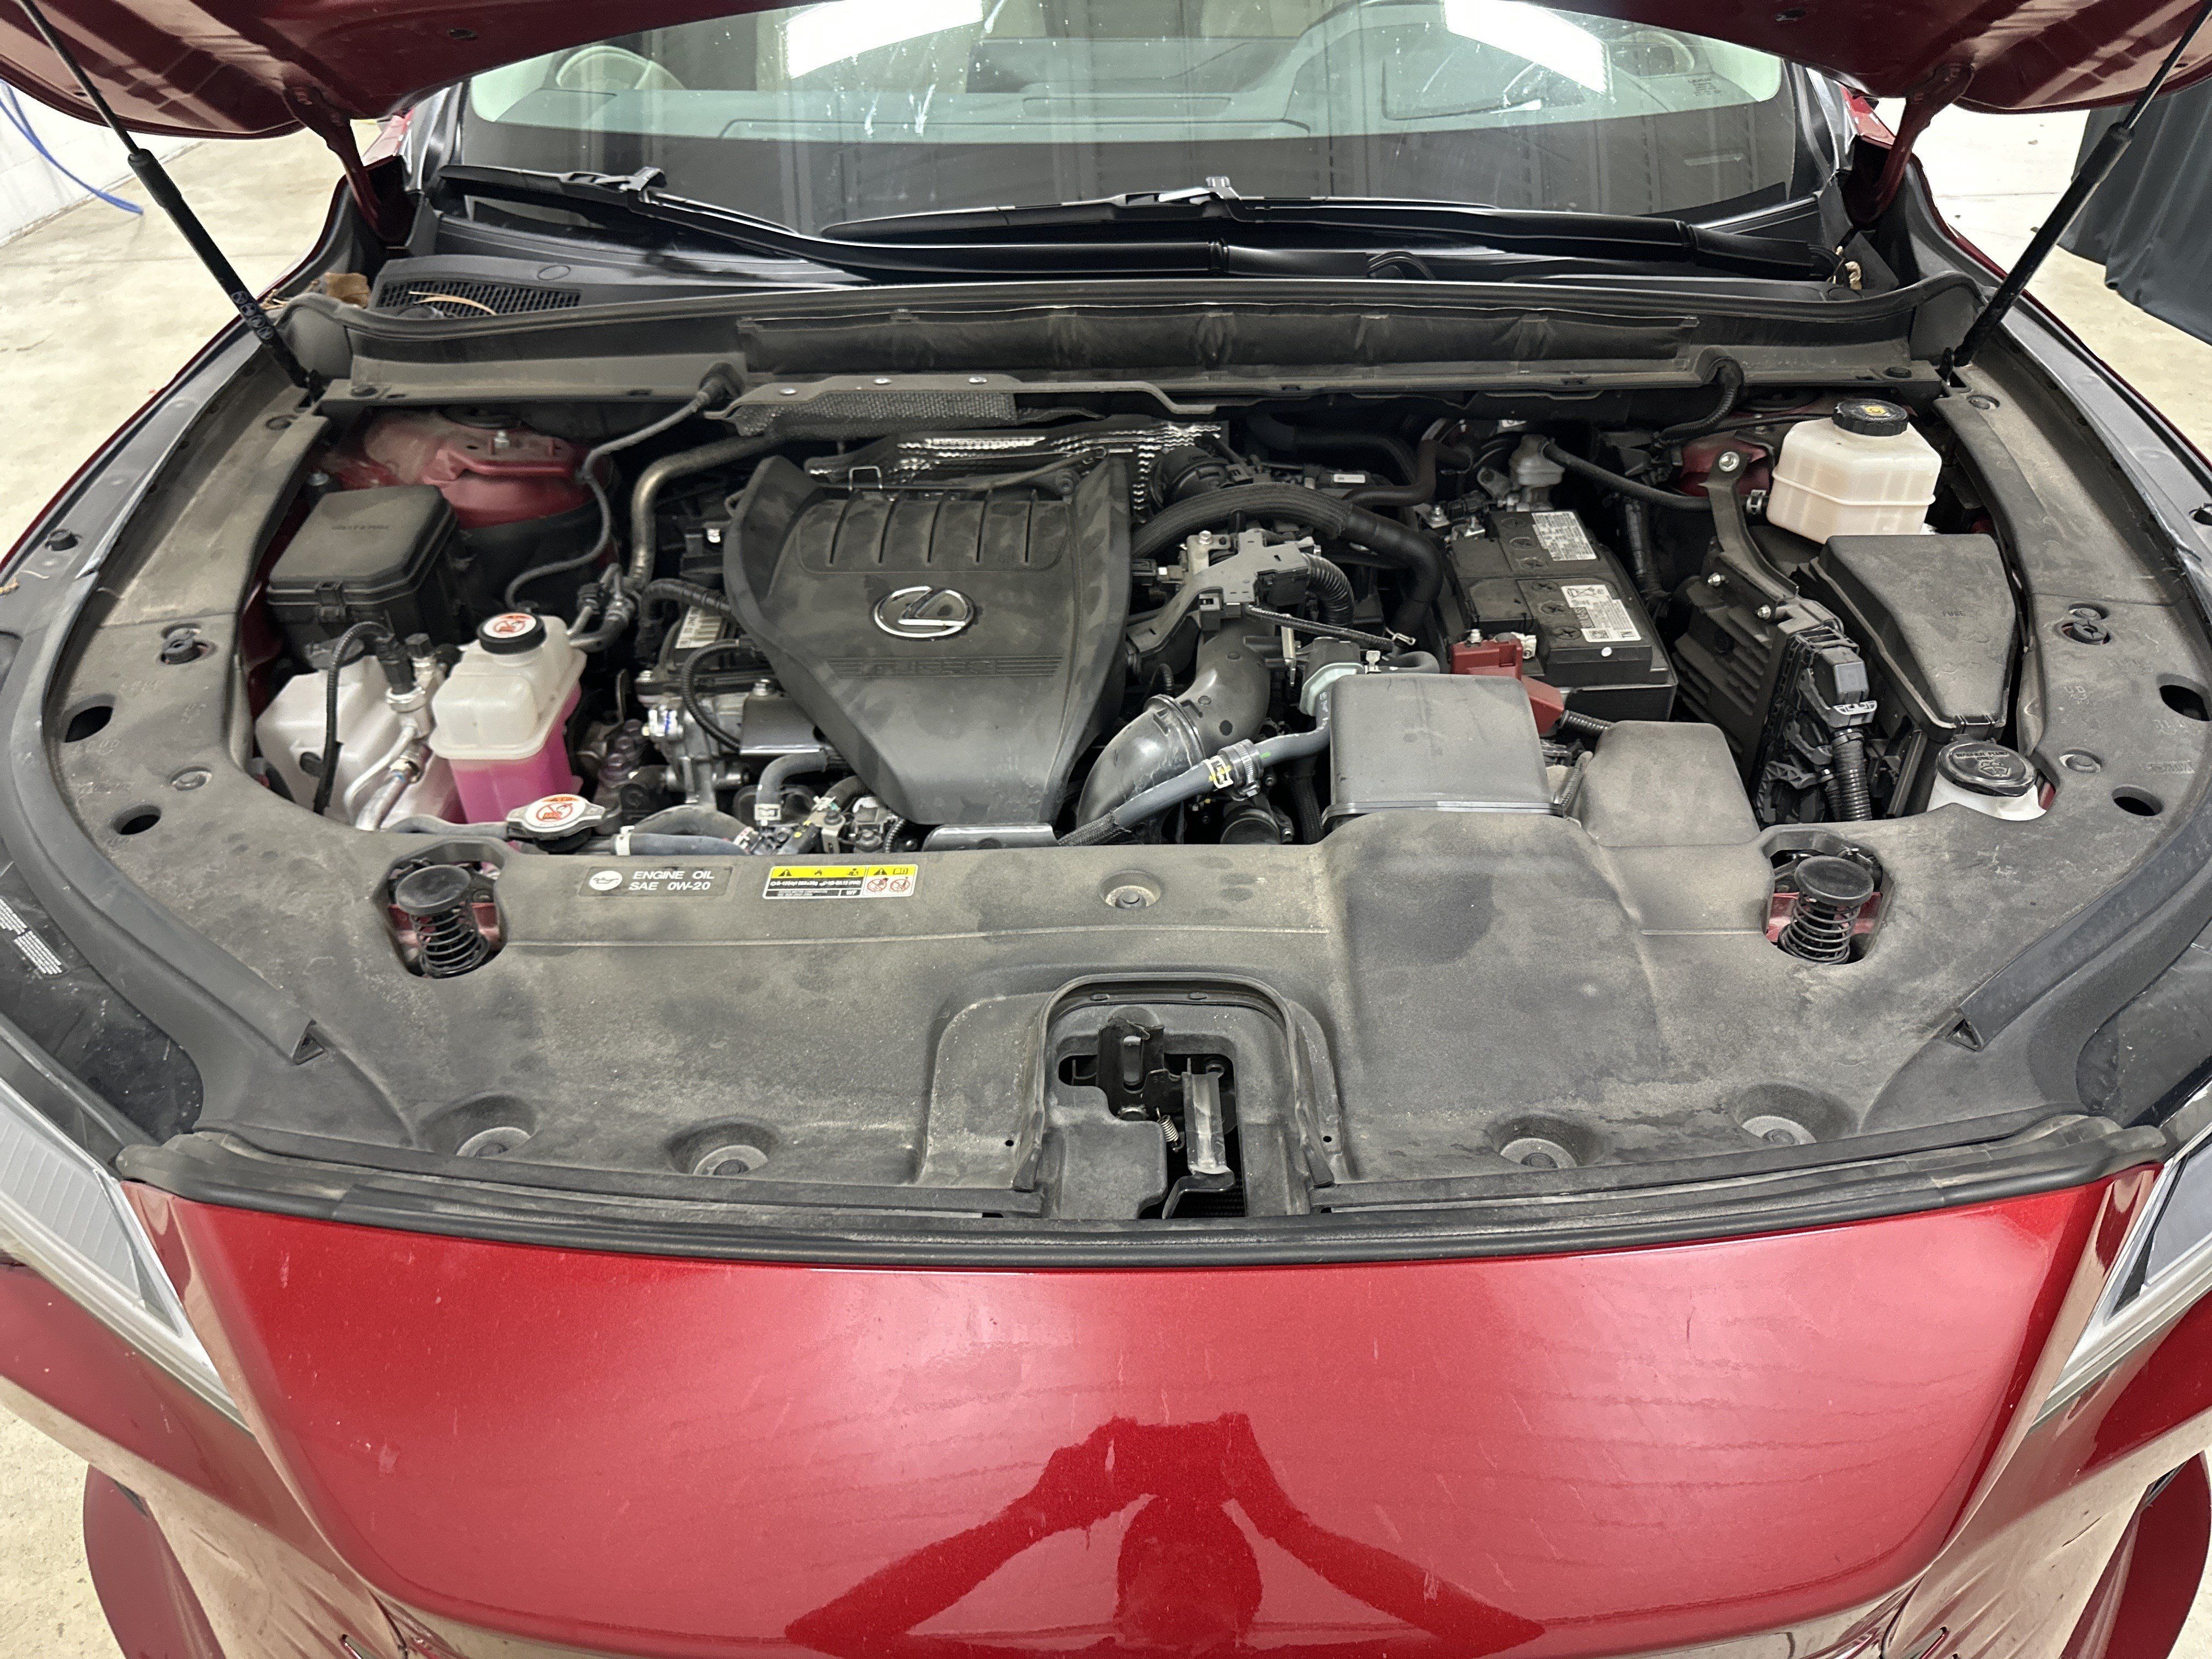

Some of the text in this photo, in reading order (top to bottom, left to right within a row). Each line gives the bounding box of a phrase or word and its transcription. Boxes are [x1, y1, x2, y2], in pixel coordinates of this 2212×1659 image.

[632, 870, 715, 880] ENGINE OIL
[628, 881, 711, 891] SAE 0W-20
